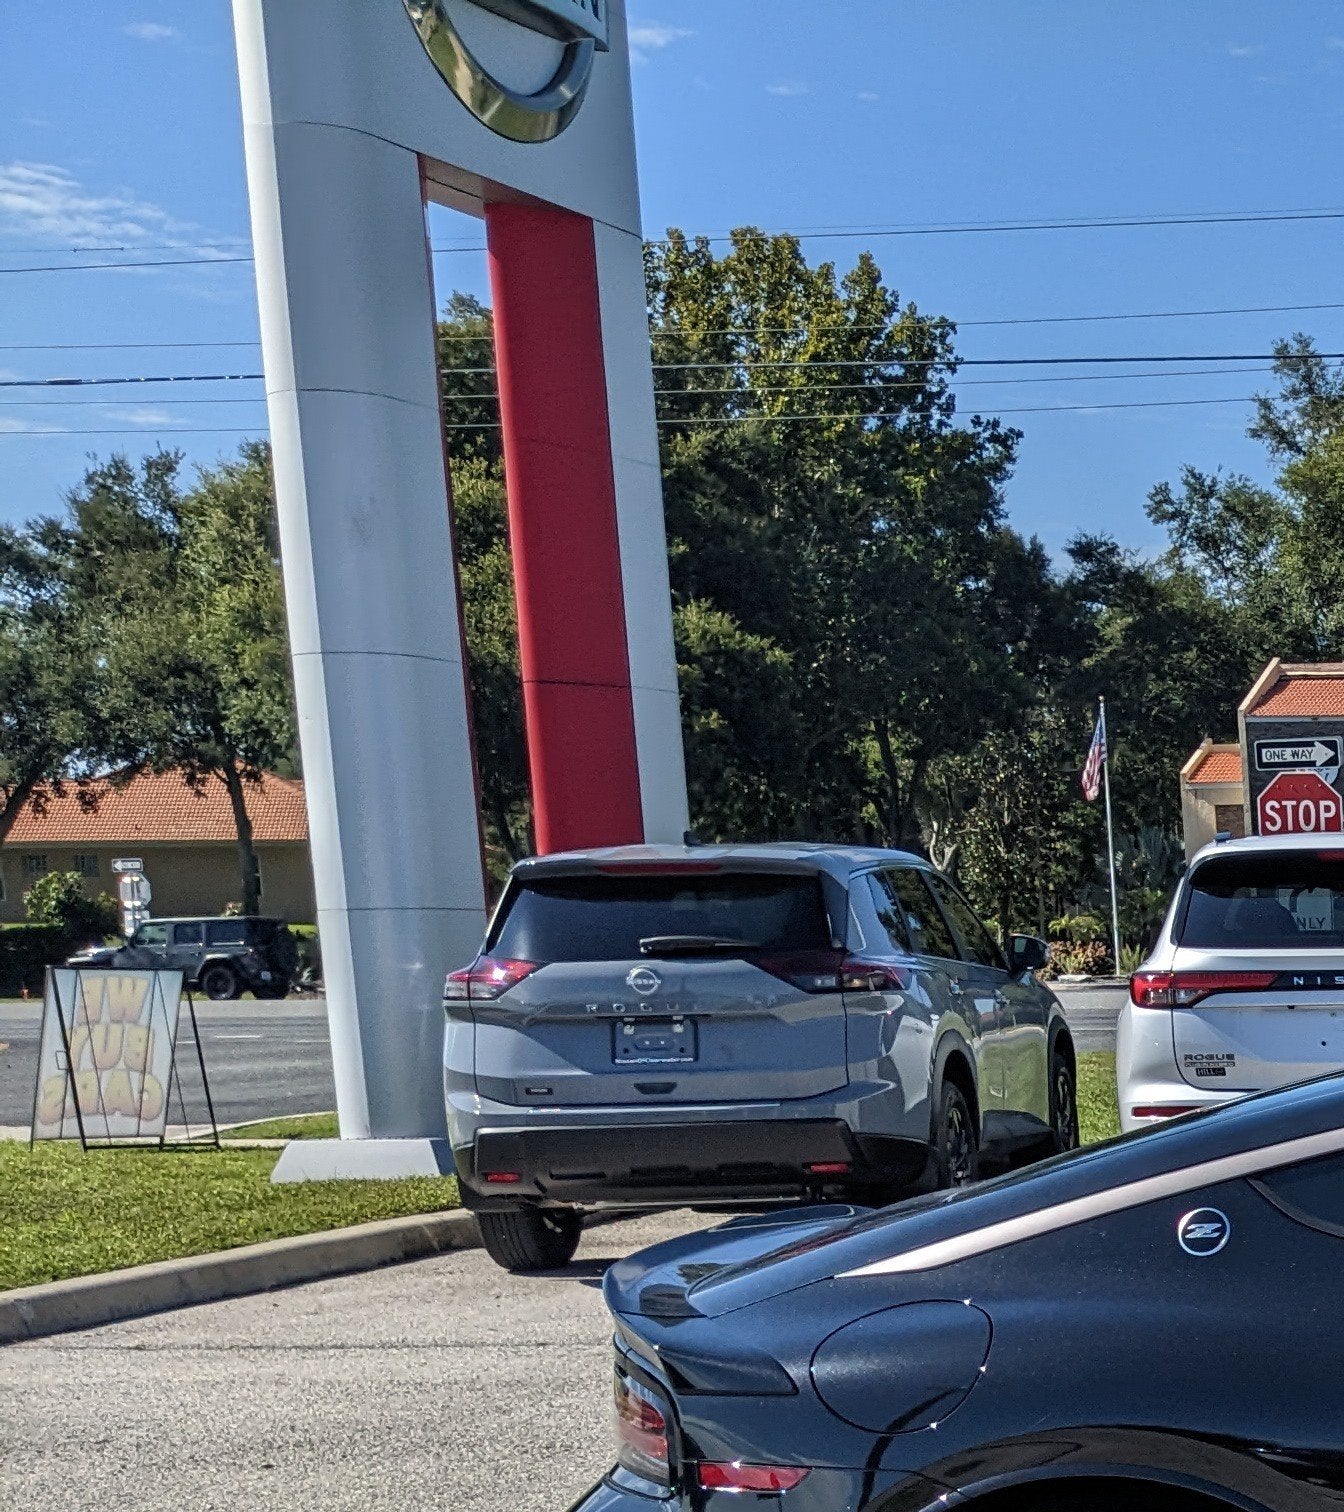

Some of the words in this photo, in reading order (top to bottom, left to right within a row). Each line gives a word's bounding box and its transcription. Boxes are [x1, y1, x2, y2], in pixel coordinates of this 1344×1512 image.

[1265, 749, 1288, 761] ONE
[1291, 748, 1314, 760] WAY
[1265, 800, 1337, 831] STOP
[1297, 917, 1326, 930] NLY
[585, 1003, 702, 1013] ROGU
